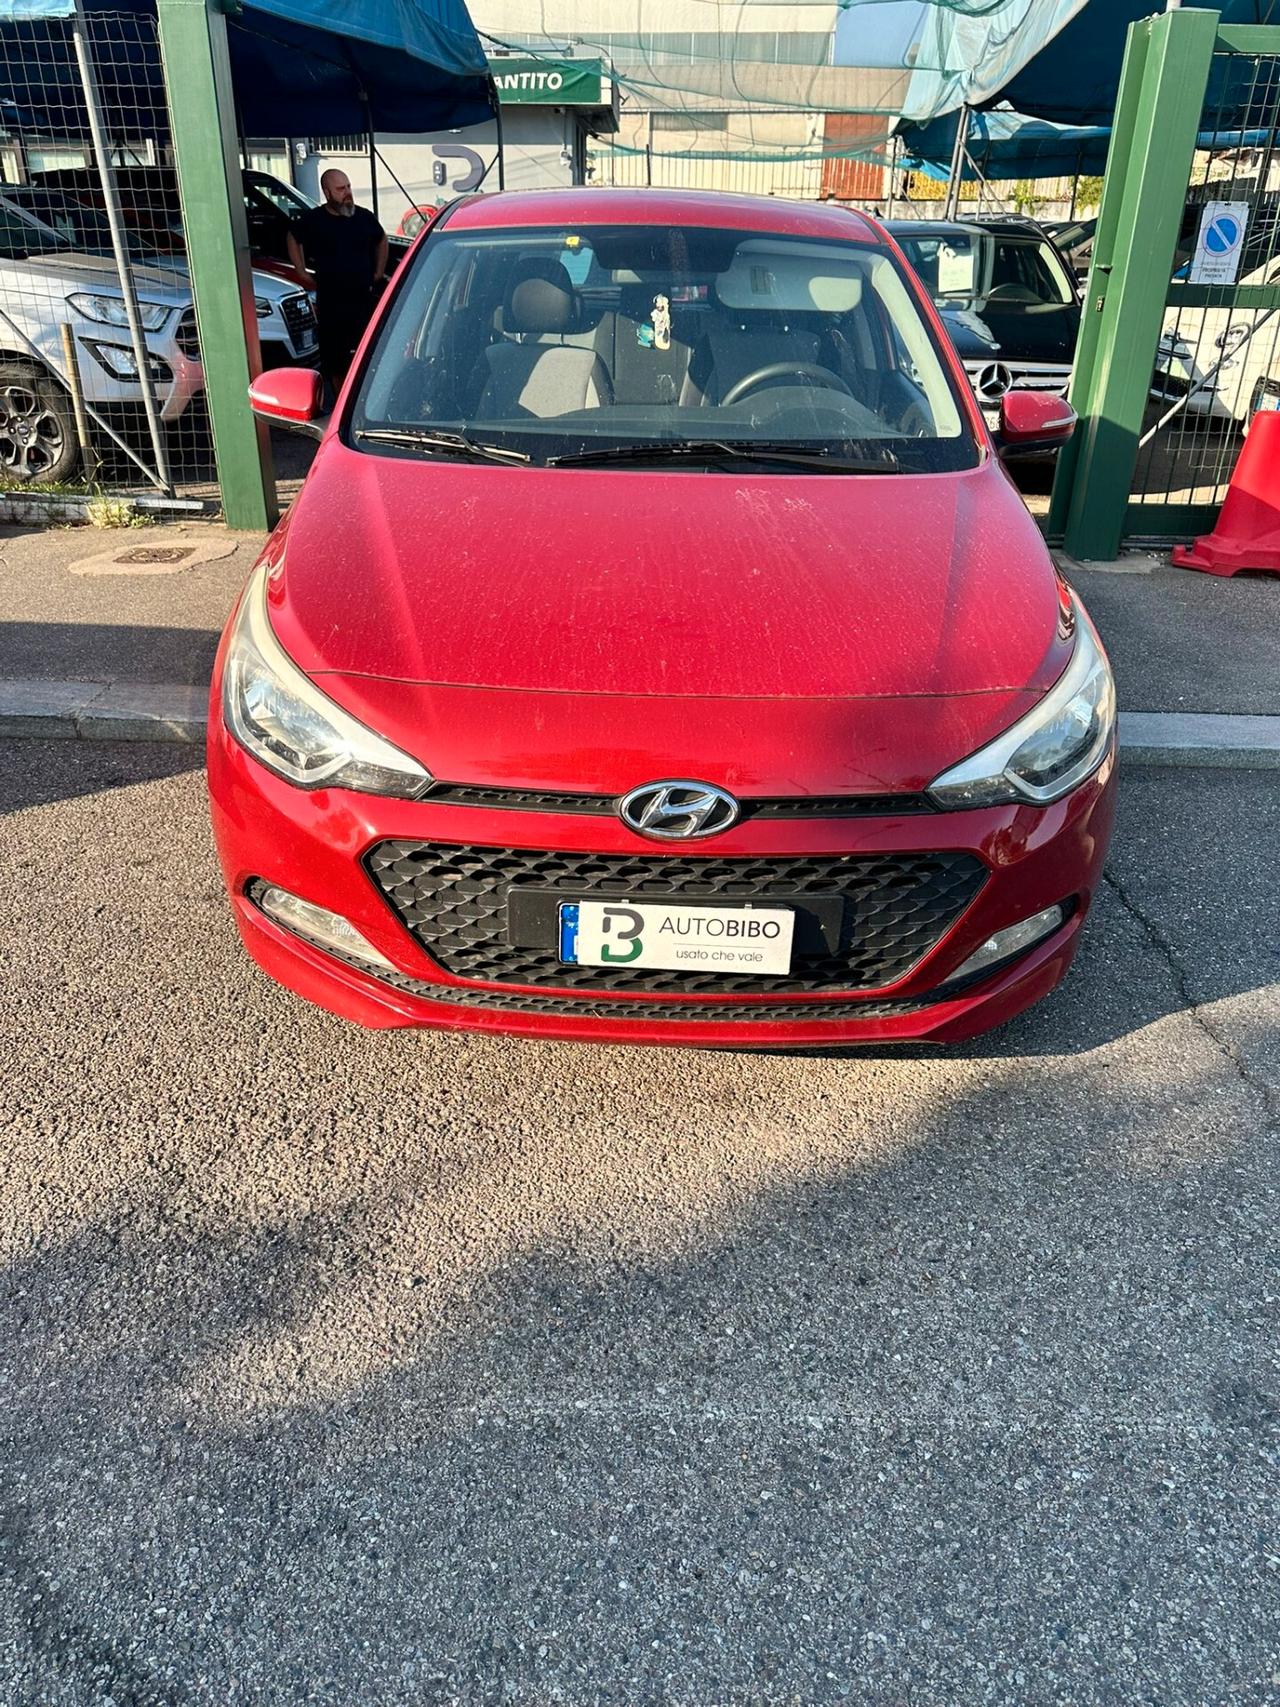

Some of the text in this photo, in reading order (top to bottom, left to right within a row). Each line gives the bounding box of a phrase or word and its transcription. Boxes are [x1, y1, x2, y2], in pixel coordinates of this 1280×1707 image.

[659, 916, 781, 939] AUTOBIBO
[676, 948, 763, 962] usato che vale
